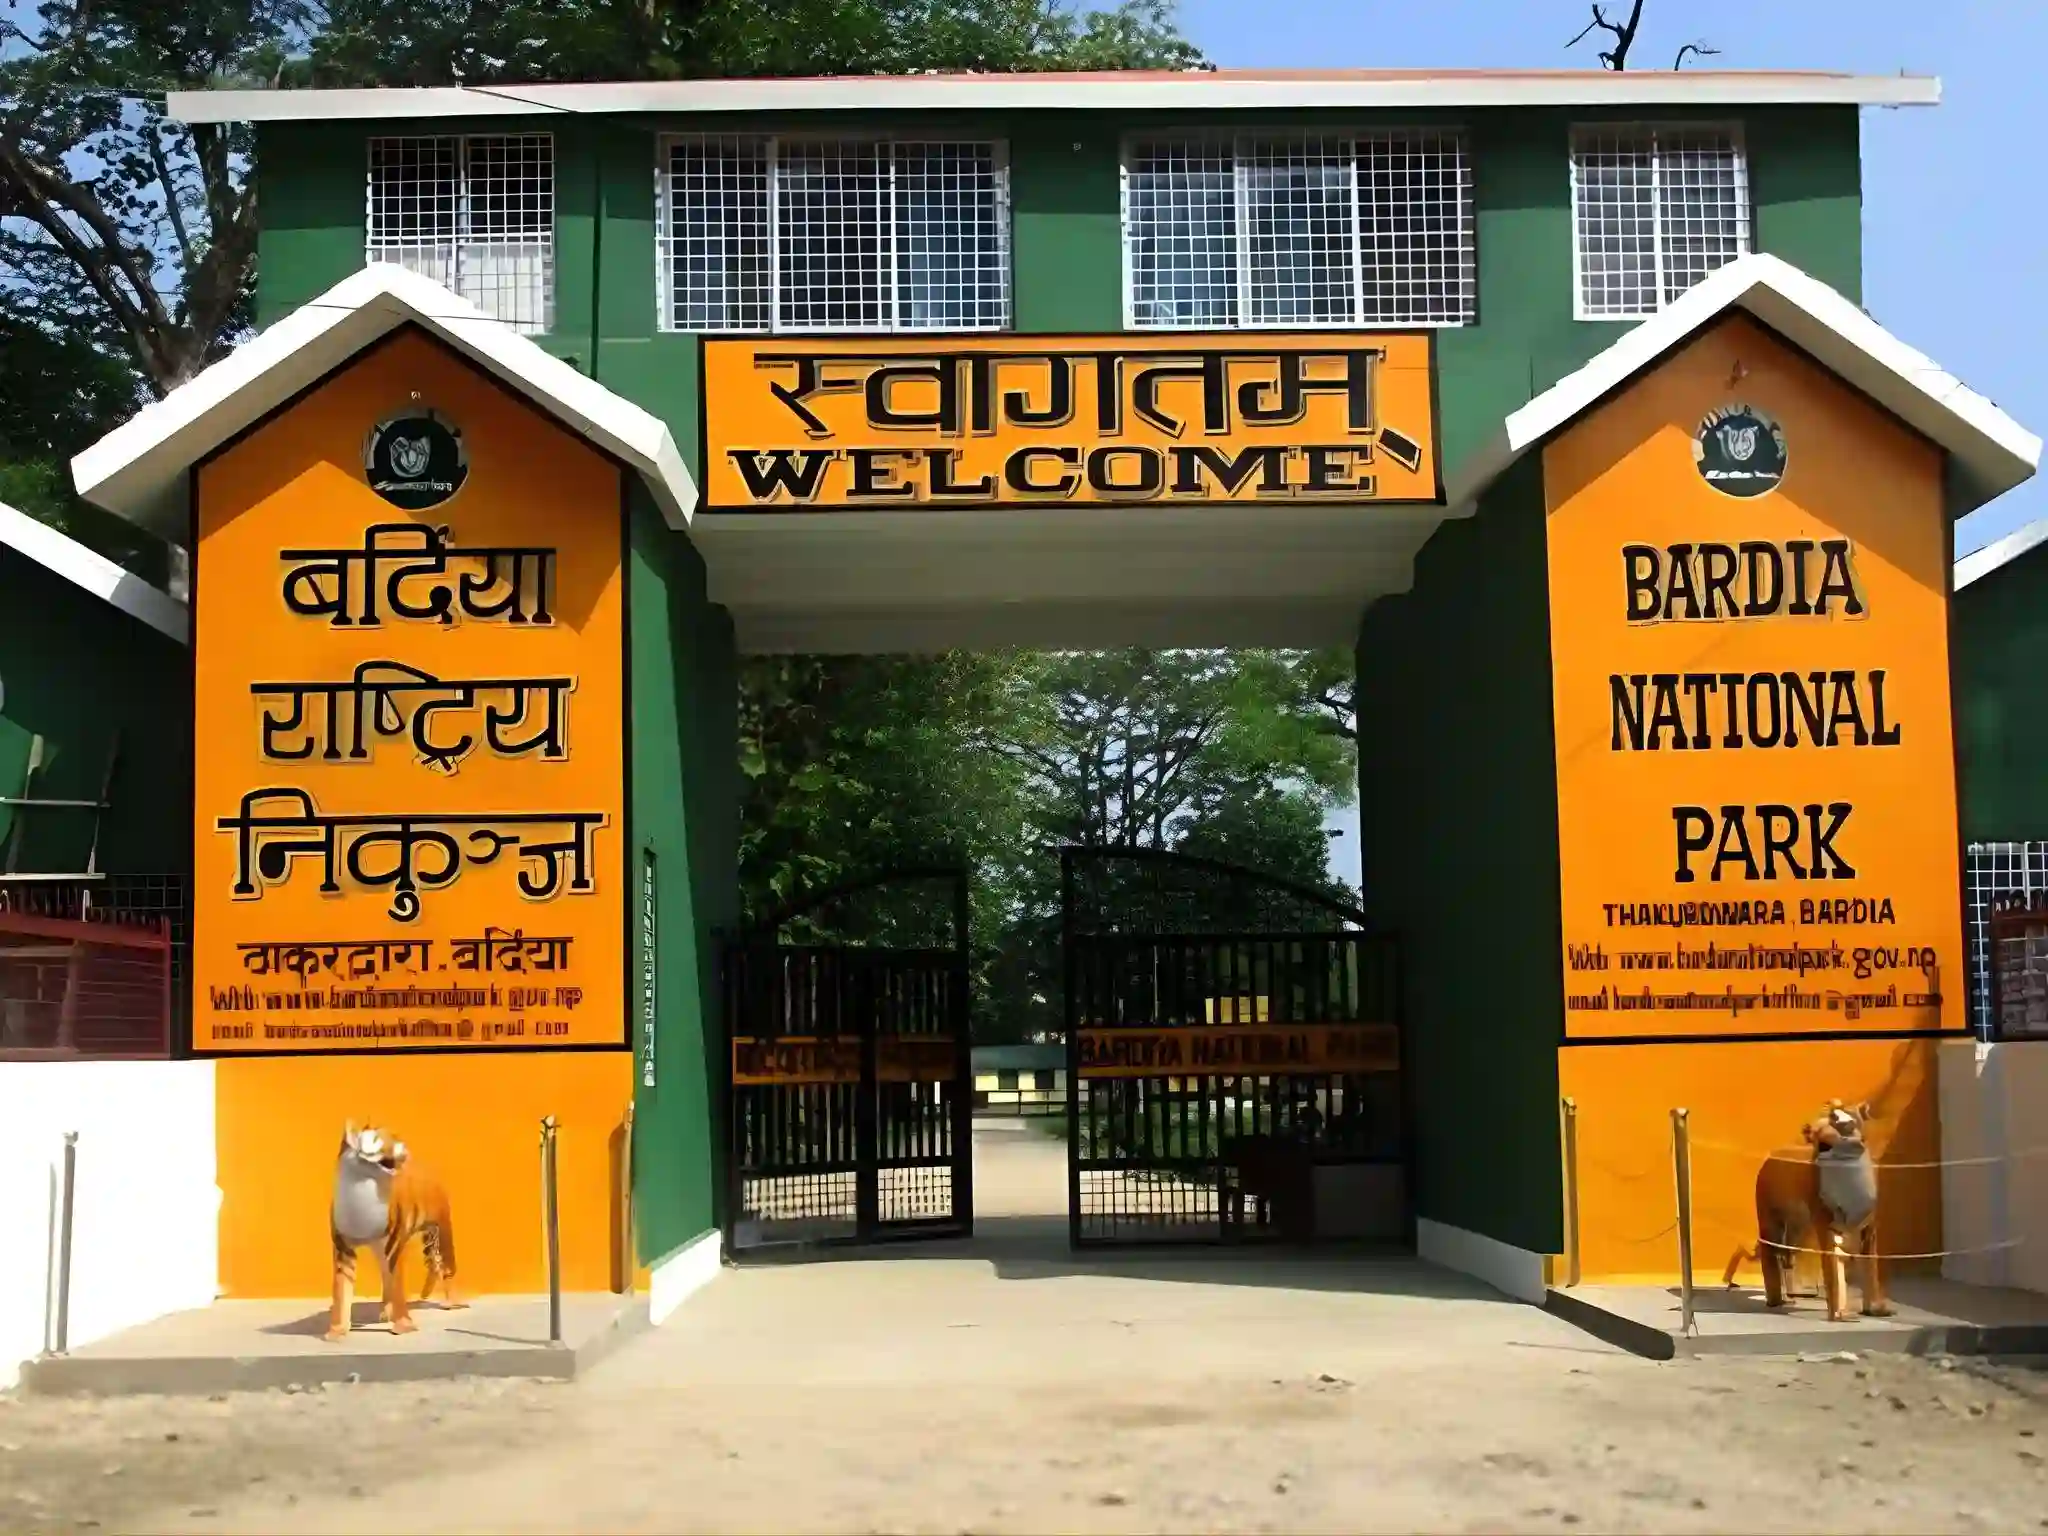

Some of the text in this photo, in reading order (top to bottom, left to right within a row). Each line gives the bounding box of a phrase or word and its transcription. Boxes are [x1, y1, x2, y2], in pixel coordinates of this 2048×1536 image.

[753, 348, 1421, 472] स्वागतम्
[727, 445, 1377, 502] WELCOME
[1622, 540, 1864, 622] BARDIA
[1609, 670, 1900, 751] NATIONAL
[1672, 803, 1856, 882] PARK
[1799, 898, 1896, 925] BARDIA
